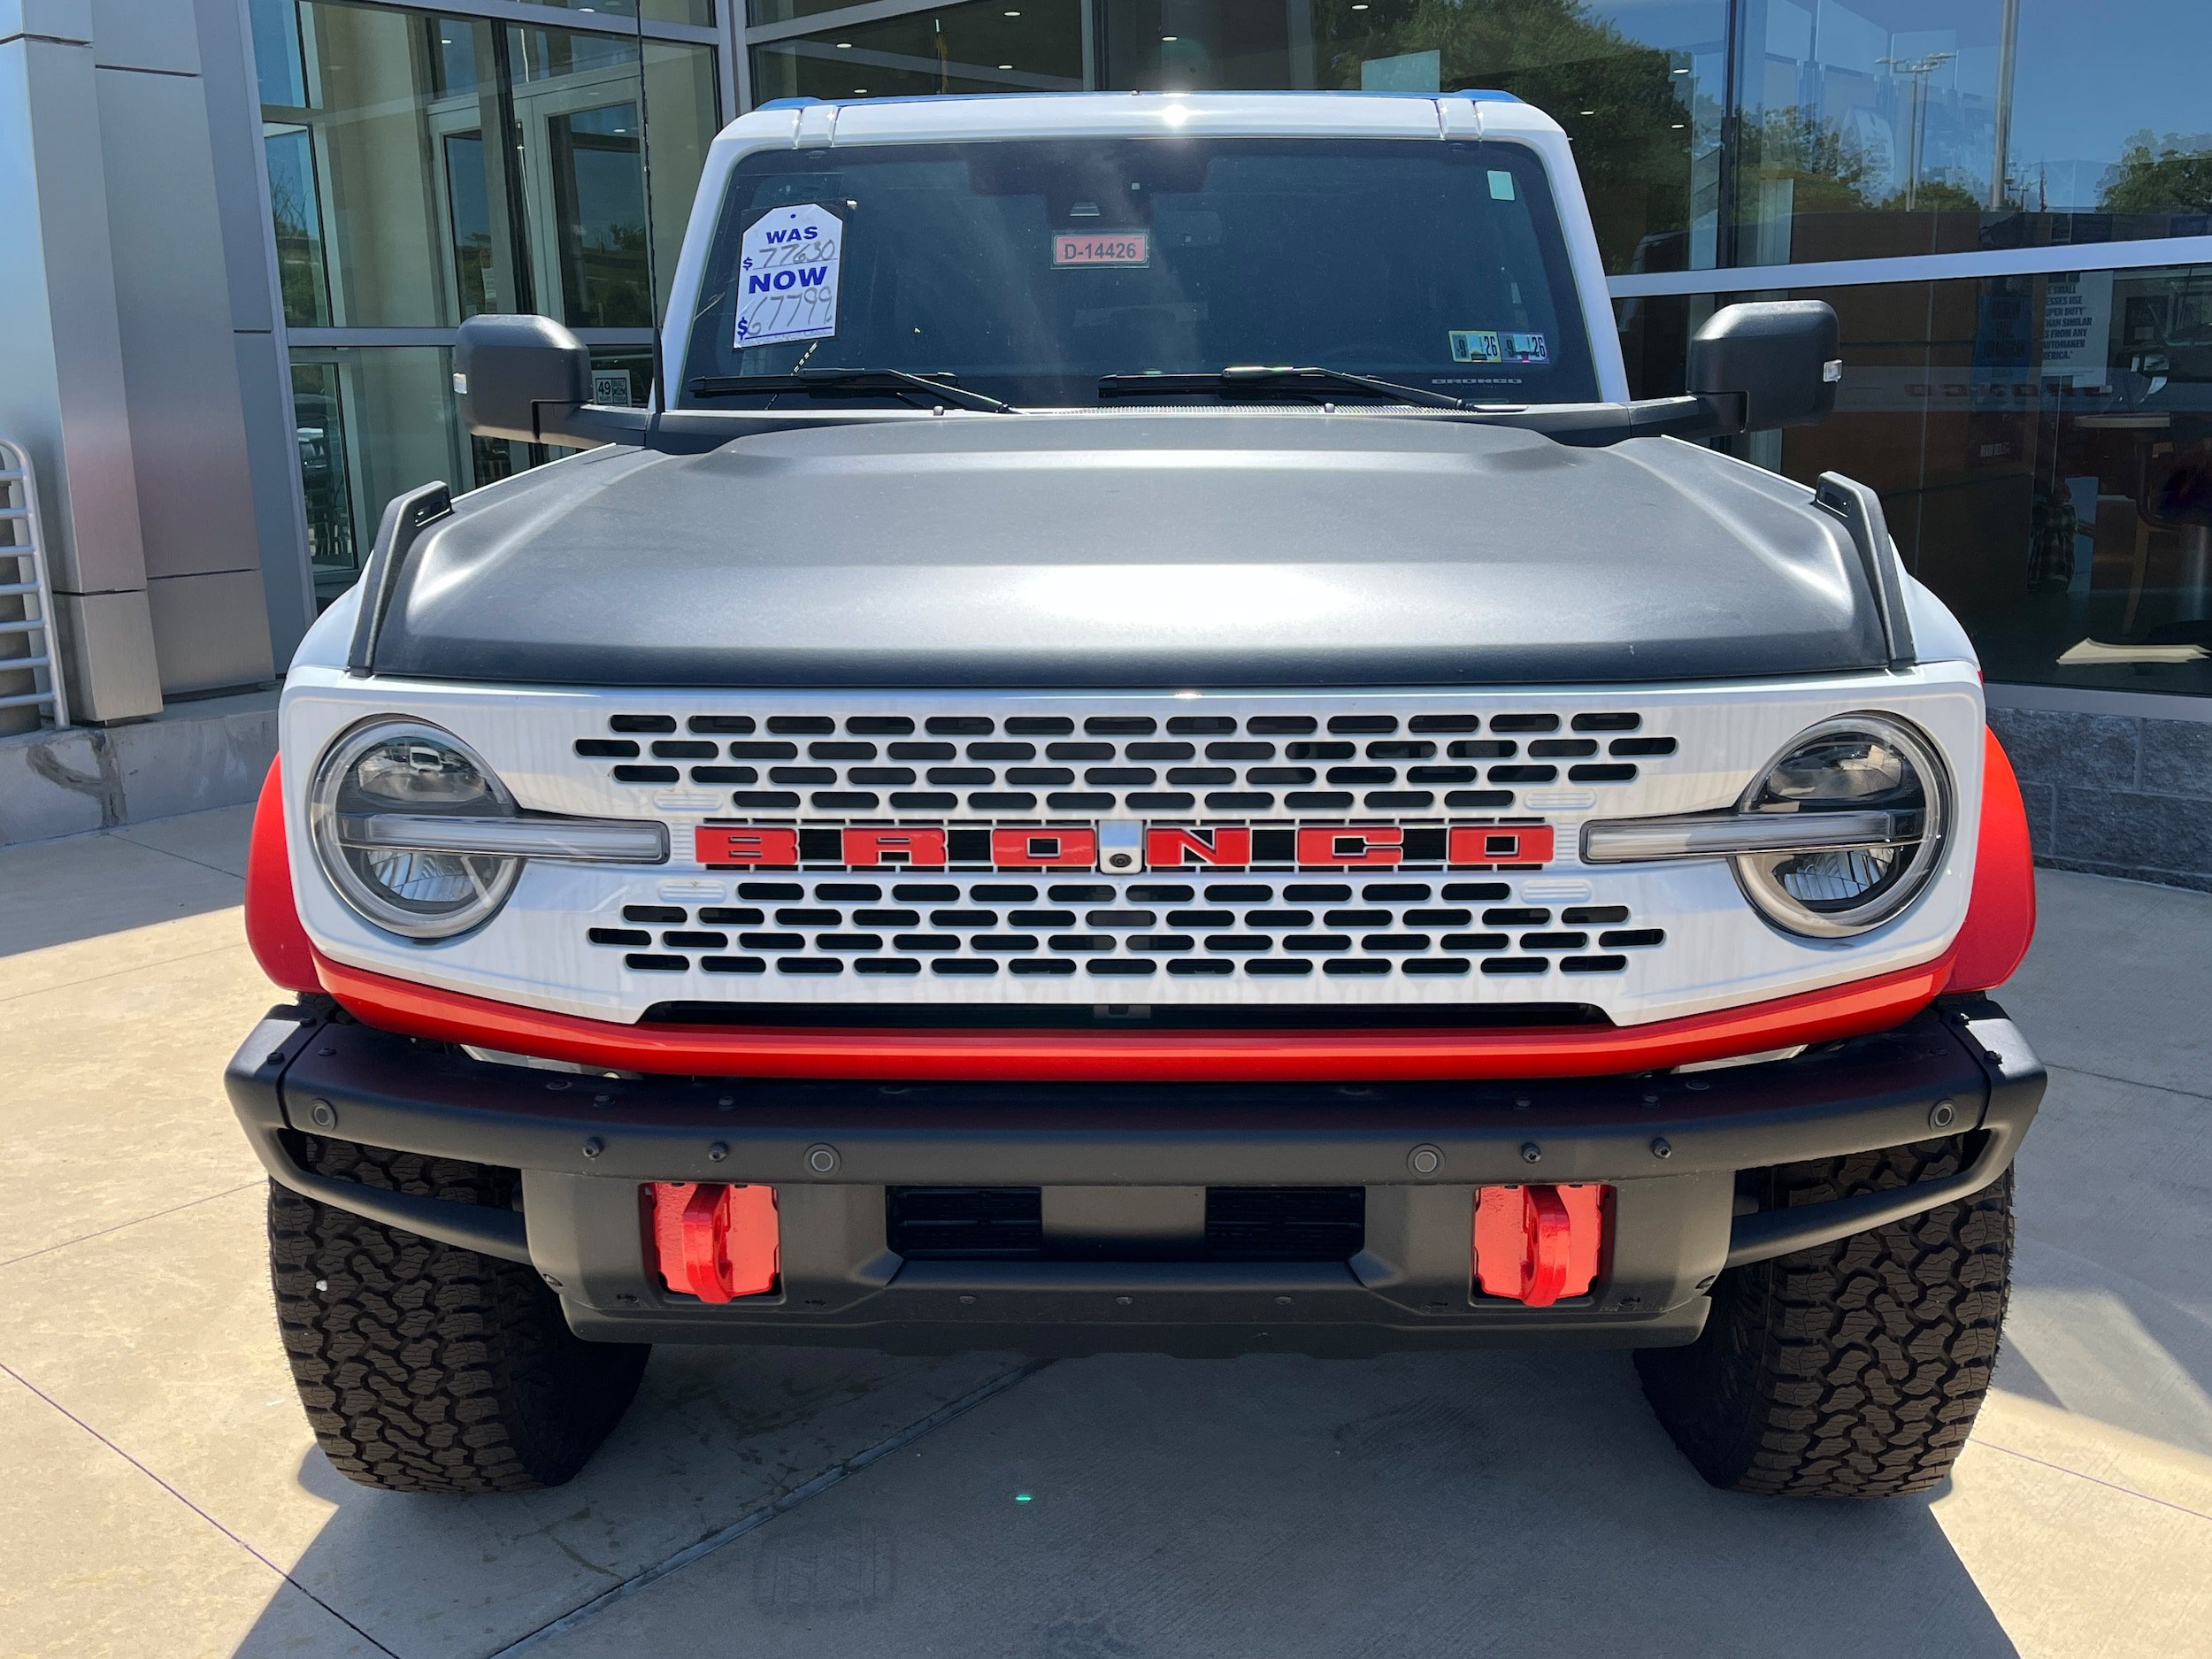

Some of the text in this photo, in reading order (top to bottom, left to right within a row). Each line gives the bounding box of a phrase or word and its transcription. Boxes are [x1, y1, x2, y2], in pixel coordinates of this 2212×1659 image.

[766, 226, 818, 244] WAS
[1064, 242, 1136, 259] D-14426
[749, 266, 828, 295] NOW
[2070, 295, 2083, 305] USE
[2062, 317, 2093, 327] SIMILAR
[2050, 328, 2071, 338] FROM
[2073, 328, 2088, 337] ANY
[1484, 335, 1498, 357] 26
[1532, 336, 1547, 357] 26
[599, 381, 611, 395] 49
[695, 825, 1555, 867] BRONCO
